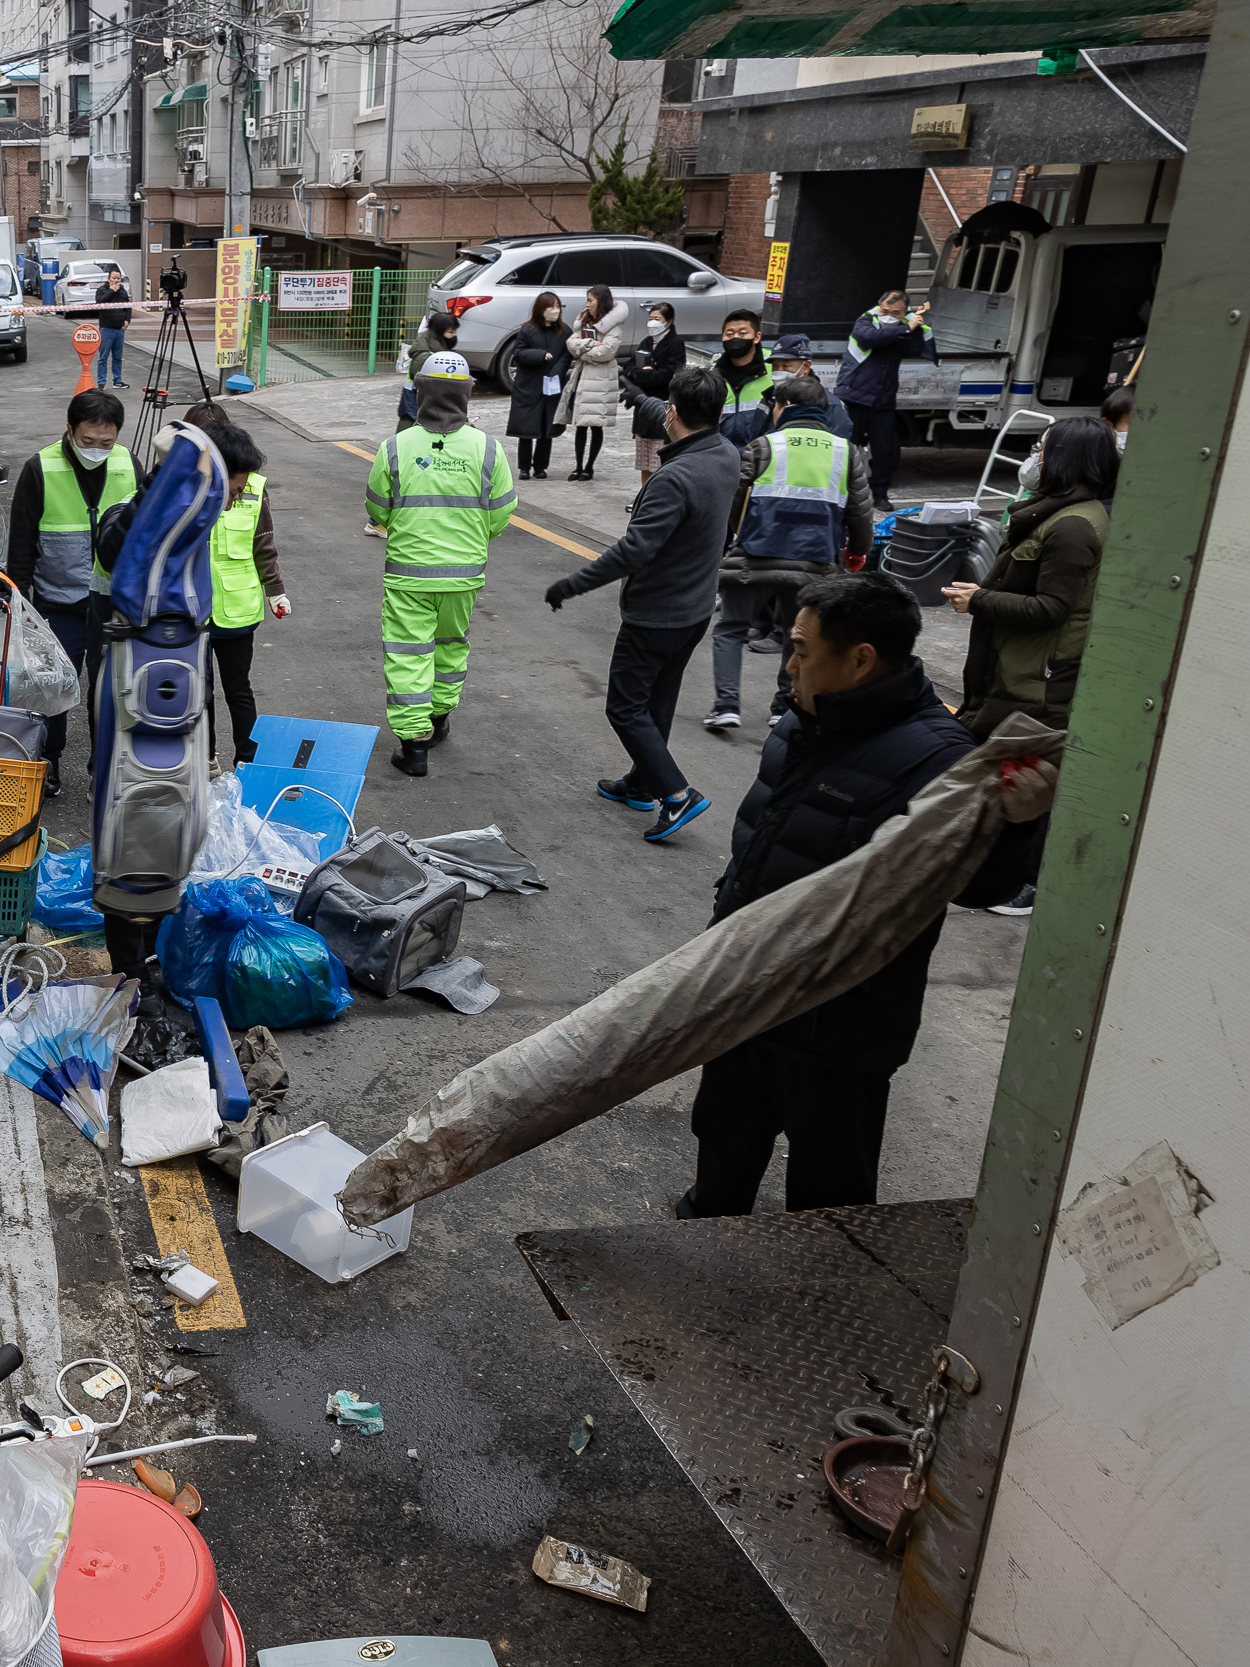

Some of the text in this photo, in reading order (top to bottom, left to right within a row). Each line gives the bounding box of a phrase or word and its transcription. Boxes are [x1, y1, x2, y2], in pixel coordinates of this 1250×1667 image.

[283, 276, 348, 288] 무단투기 집중단속
[767, 273, 783, 291] 금지
[218, 243, 241, 349] 분양사무실
[786, 436, 833, 449] 광진구
